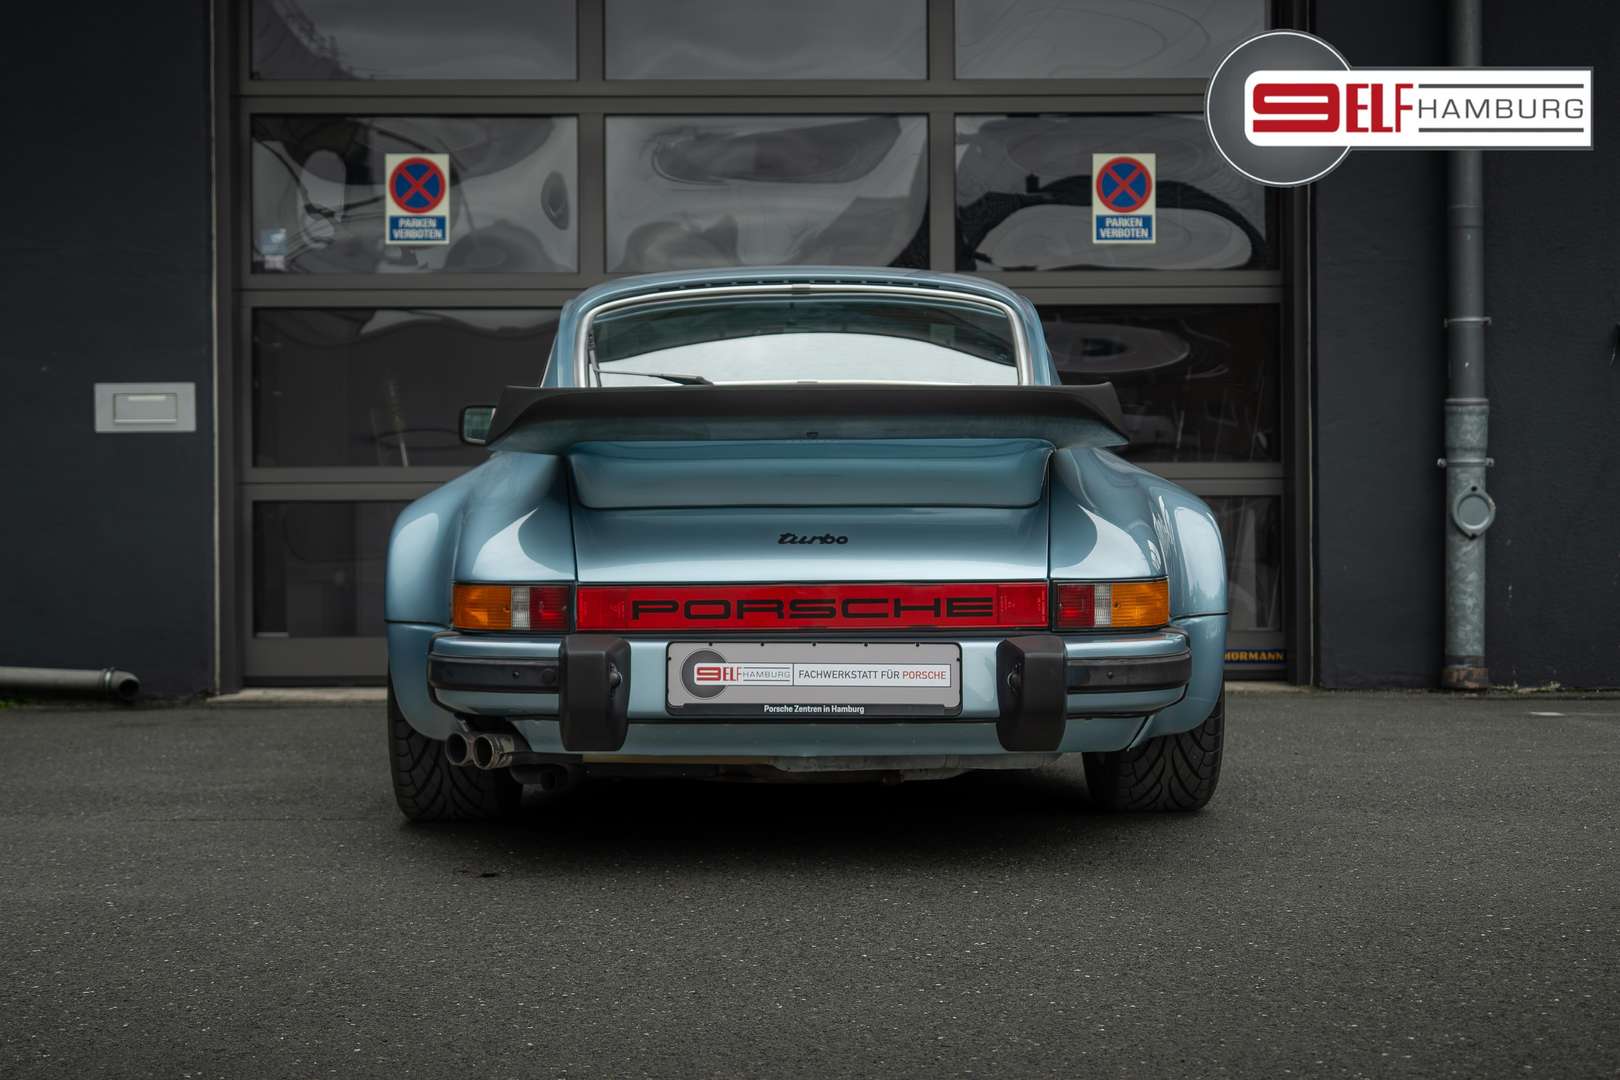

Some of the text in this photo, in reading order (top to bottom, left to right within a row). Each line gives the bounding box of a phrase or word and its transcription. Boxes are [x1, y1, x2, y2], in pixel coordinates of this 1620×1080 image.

[398, 217, 437, 227] PARKEN
[1105, 217, 1143, 227] PARKEN
[1099, 228, 1149, 238] VERBOTEN
[777, 532, 849, 545] turbo
[631, 598, 993, 620] PORSCHE
[742, 671, 791, 679] HAMBURG
[798, 669, 947, 680] FACHWERKSTATT FÜR PORSCHE
[763, 704, 865, 715] Porsche Zentren in Hamburg
